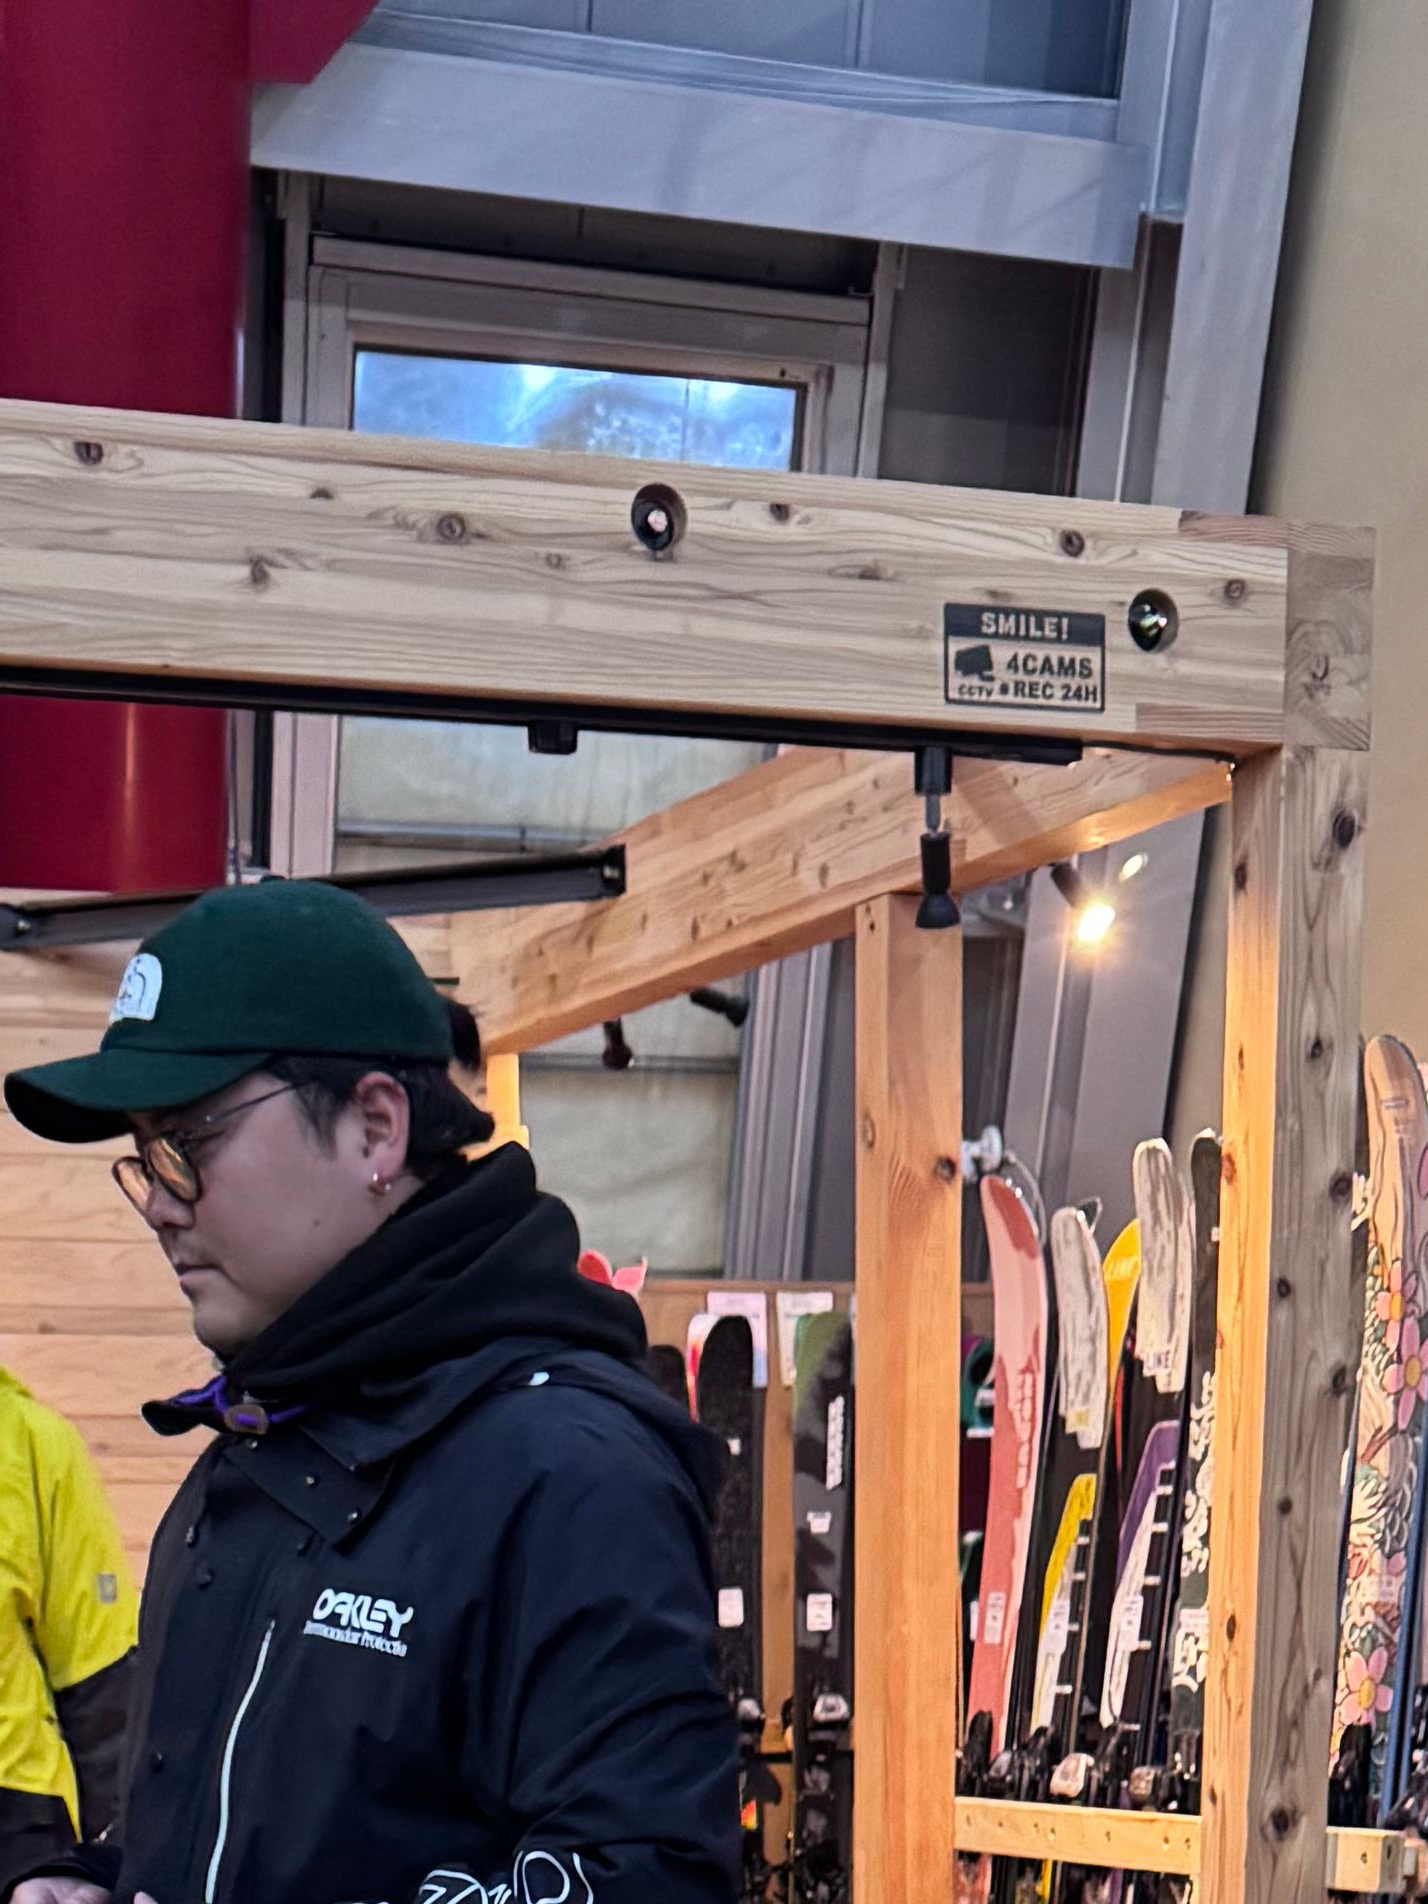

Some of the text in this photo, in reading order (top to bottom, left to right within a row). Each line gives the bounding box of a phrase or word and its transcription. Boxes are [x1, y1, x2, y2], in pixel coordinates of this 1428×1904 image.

[980, 611, 1069, 641] SMILE!
[1006, 651, 1093, 679] 4CAMS
[958, 683, 995, 698] CCTV
[1013, 680, 1098, 704] REC 24H
[312, 1588, 414, 1639] OAKLEY
